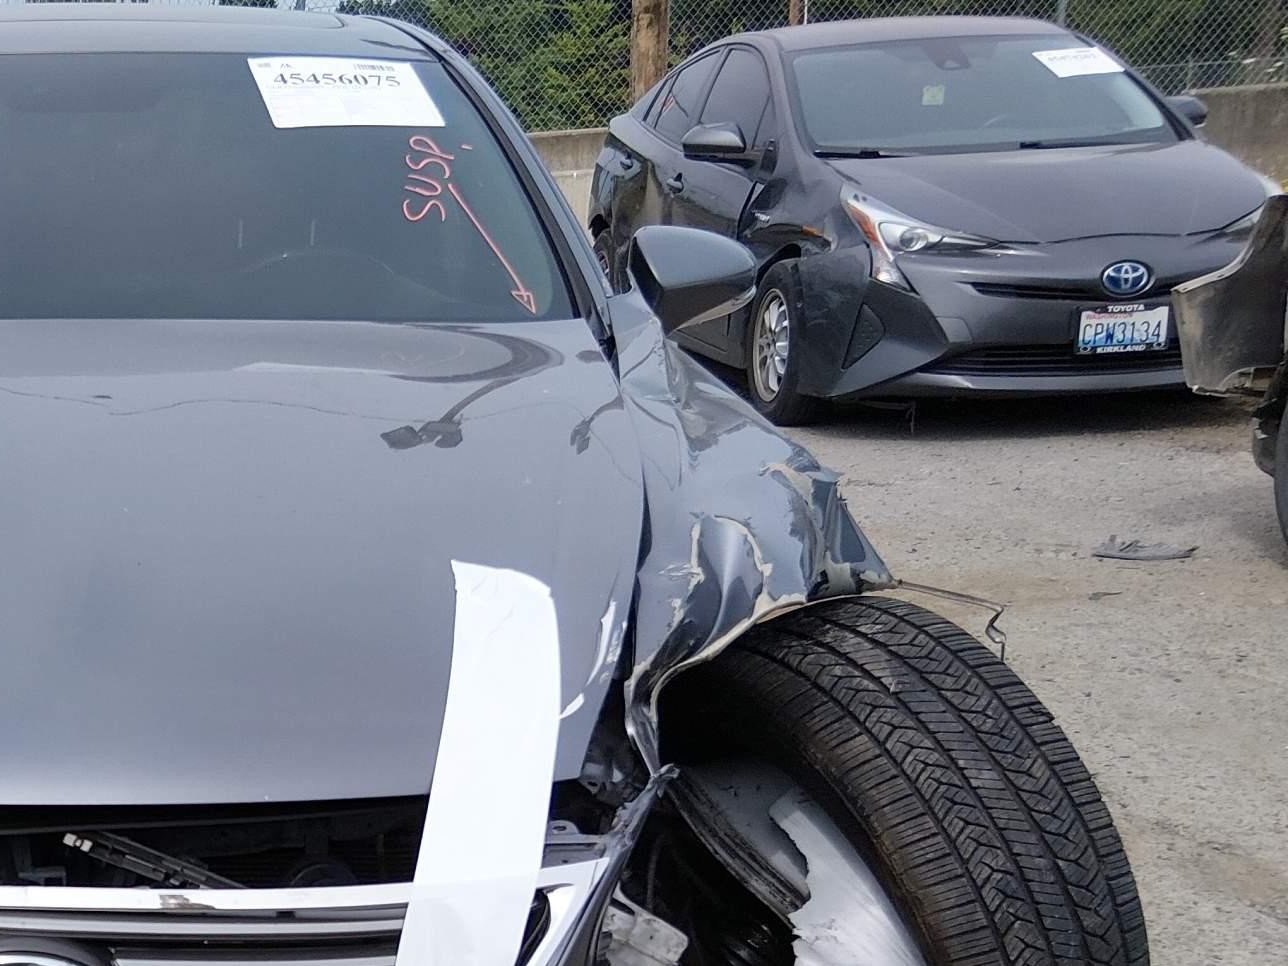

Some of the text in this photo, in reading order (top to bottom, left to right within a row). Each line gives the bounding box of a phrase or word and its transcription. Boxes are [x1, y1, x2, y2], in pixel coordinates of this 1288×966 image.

[274, 73, 401, 87] 45456075
[1107, 304, 1145, 312] TOYOTA
[1082, 320, 1161, 345] CPW3134
[1096, 344, 1146, 353] KIRKLAND
